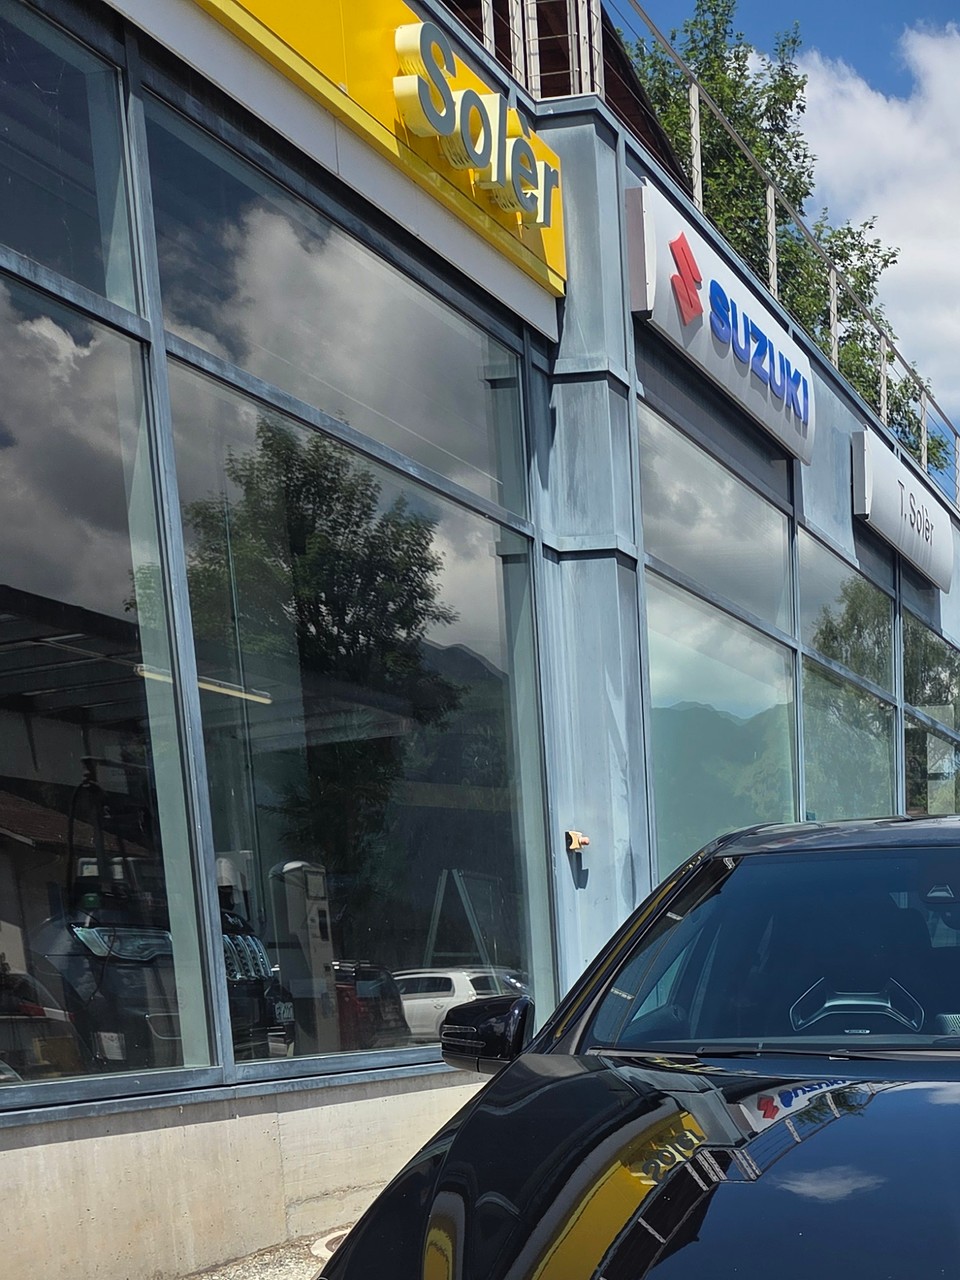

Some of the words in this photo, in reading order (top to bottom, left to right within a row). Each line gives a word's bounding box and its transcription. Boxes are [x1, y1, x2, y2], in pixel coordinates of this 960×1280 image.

[415, 21, 559, 228] Solèr
[709, 279, 808, 426] SUZUKI
[909, 493, 935, 546] Solèr
